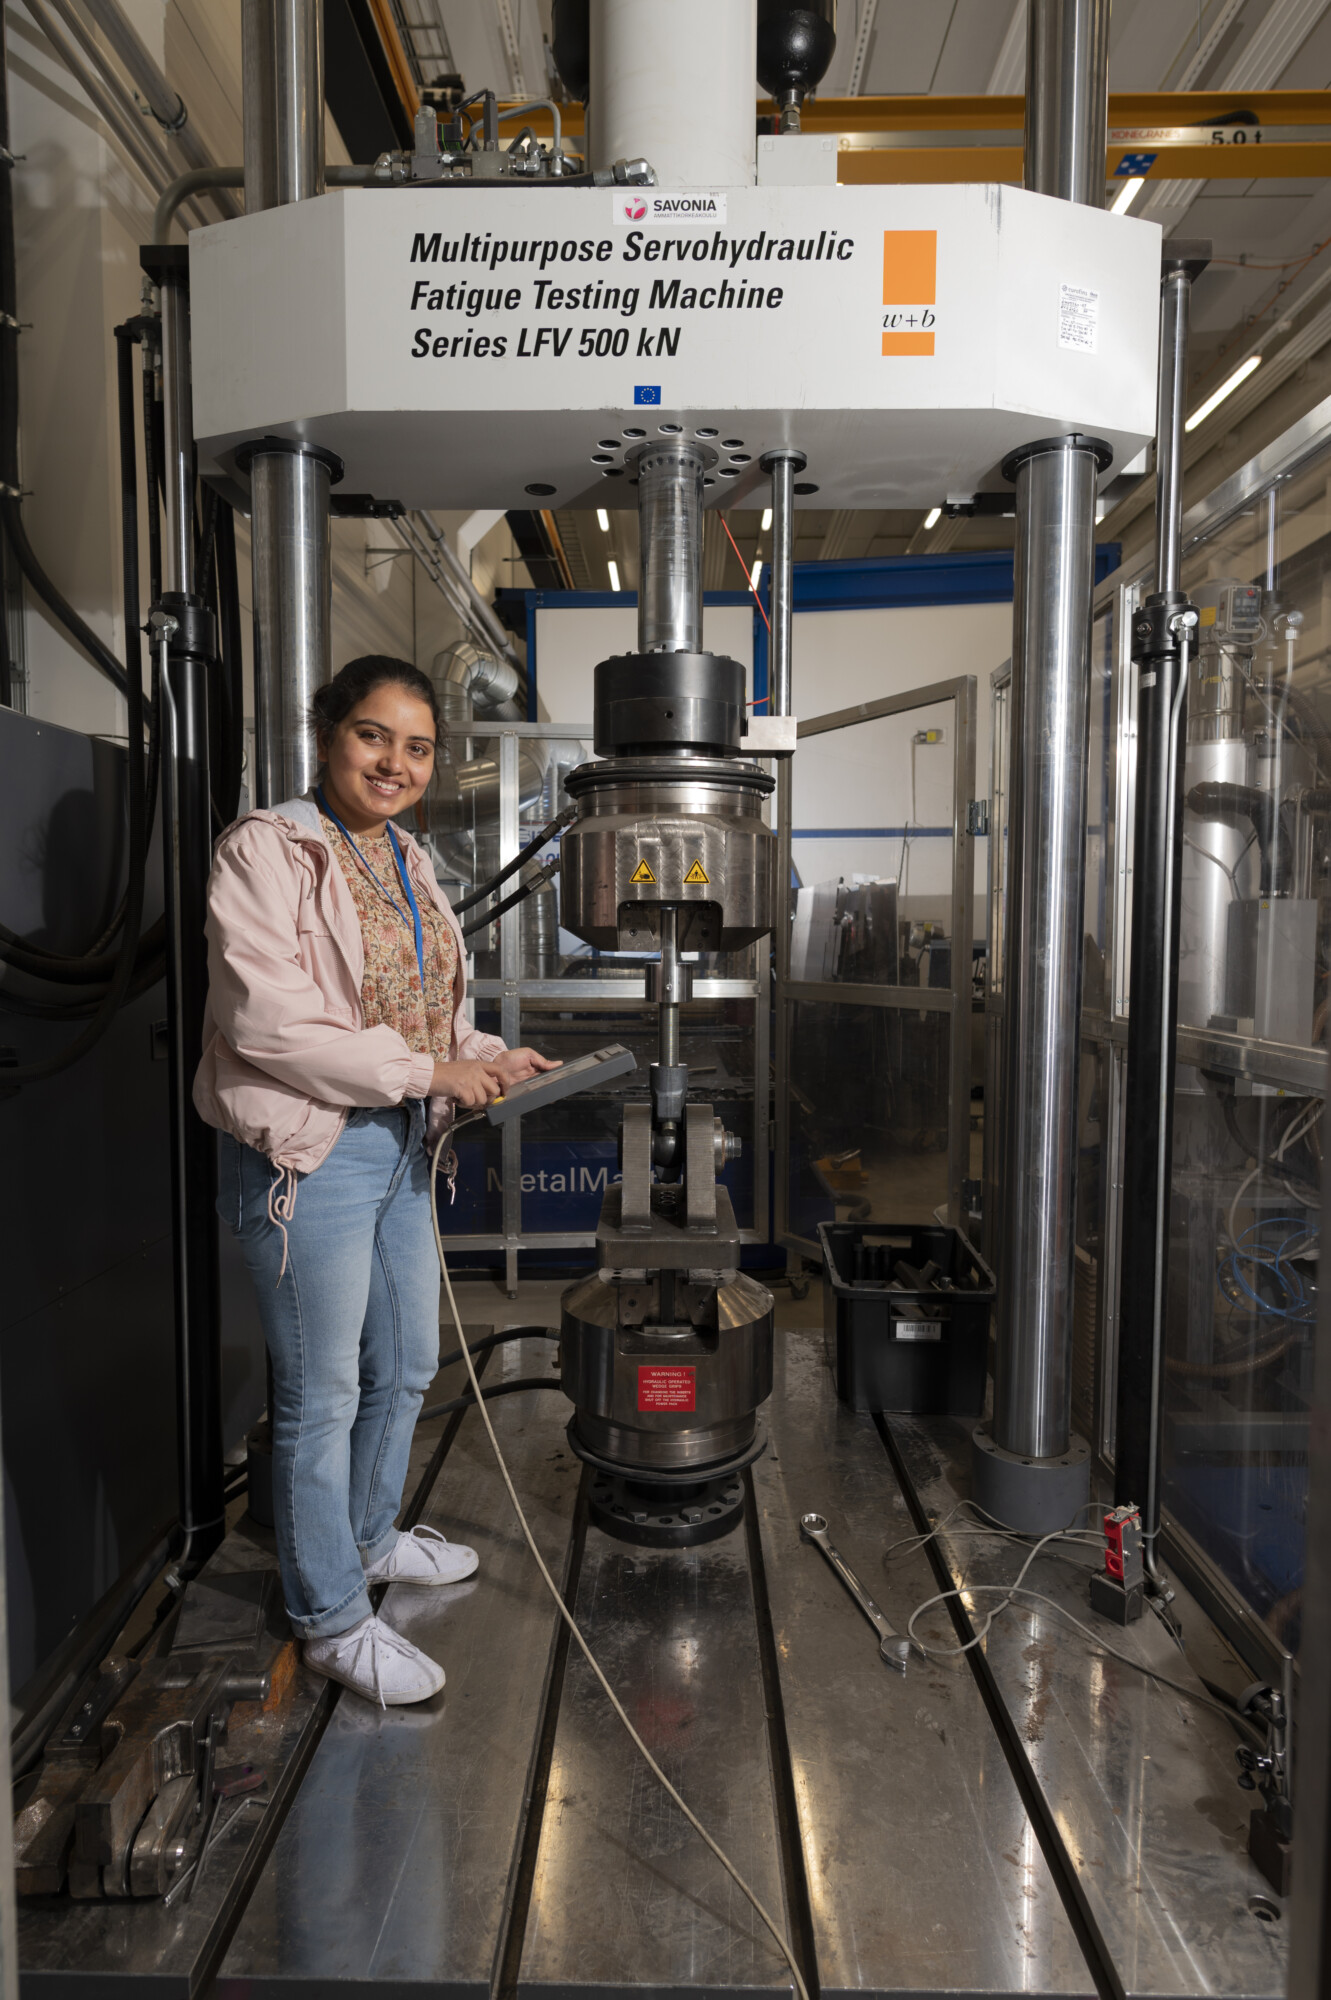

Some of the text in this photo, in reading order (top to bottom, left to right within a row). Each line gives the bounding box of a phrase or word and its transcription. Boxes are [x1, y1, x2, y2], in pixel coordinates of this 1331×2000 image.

[1212, 130, 1247, 144] 5.0
[653, 199, 717, 211] SAVONIA
[410, 231, 854, 270] Multipurpose Servohydraulic
[410, 280, 784, 318] Fatigue Testing Machine
[882, 309, 936, 328] w+b
[411, 328, 682, 358] Series LFV 500 kN
